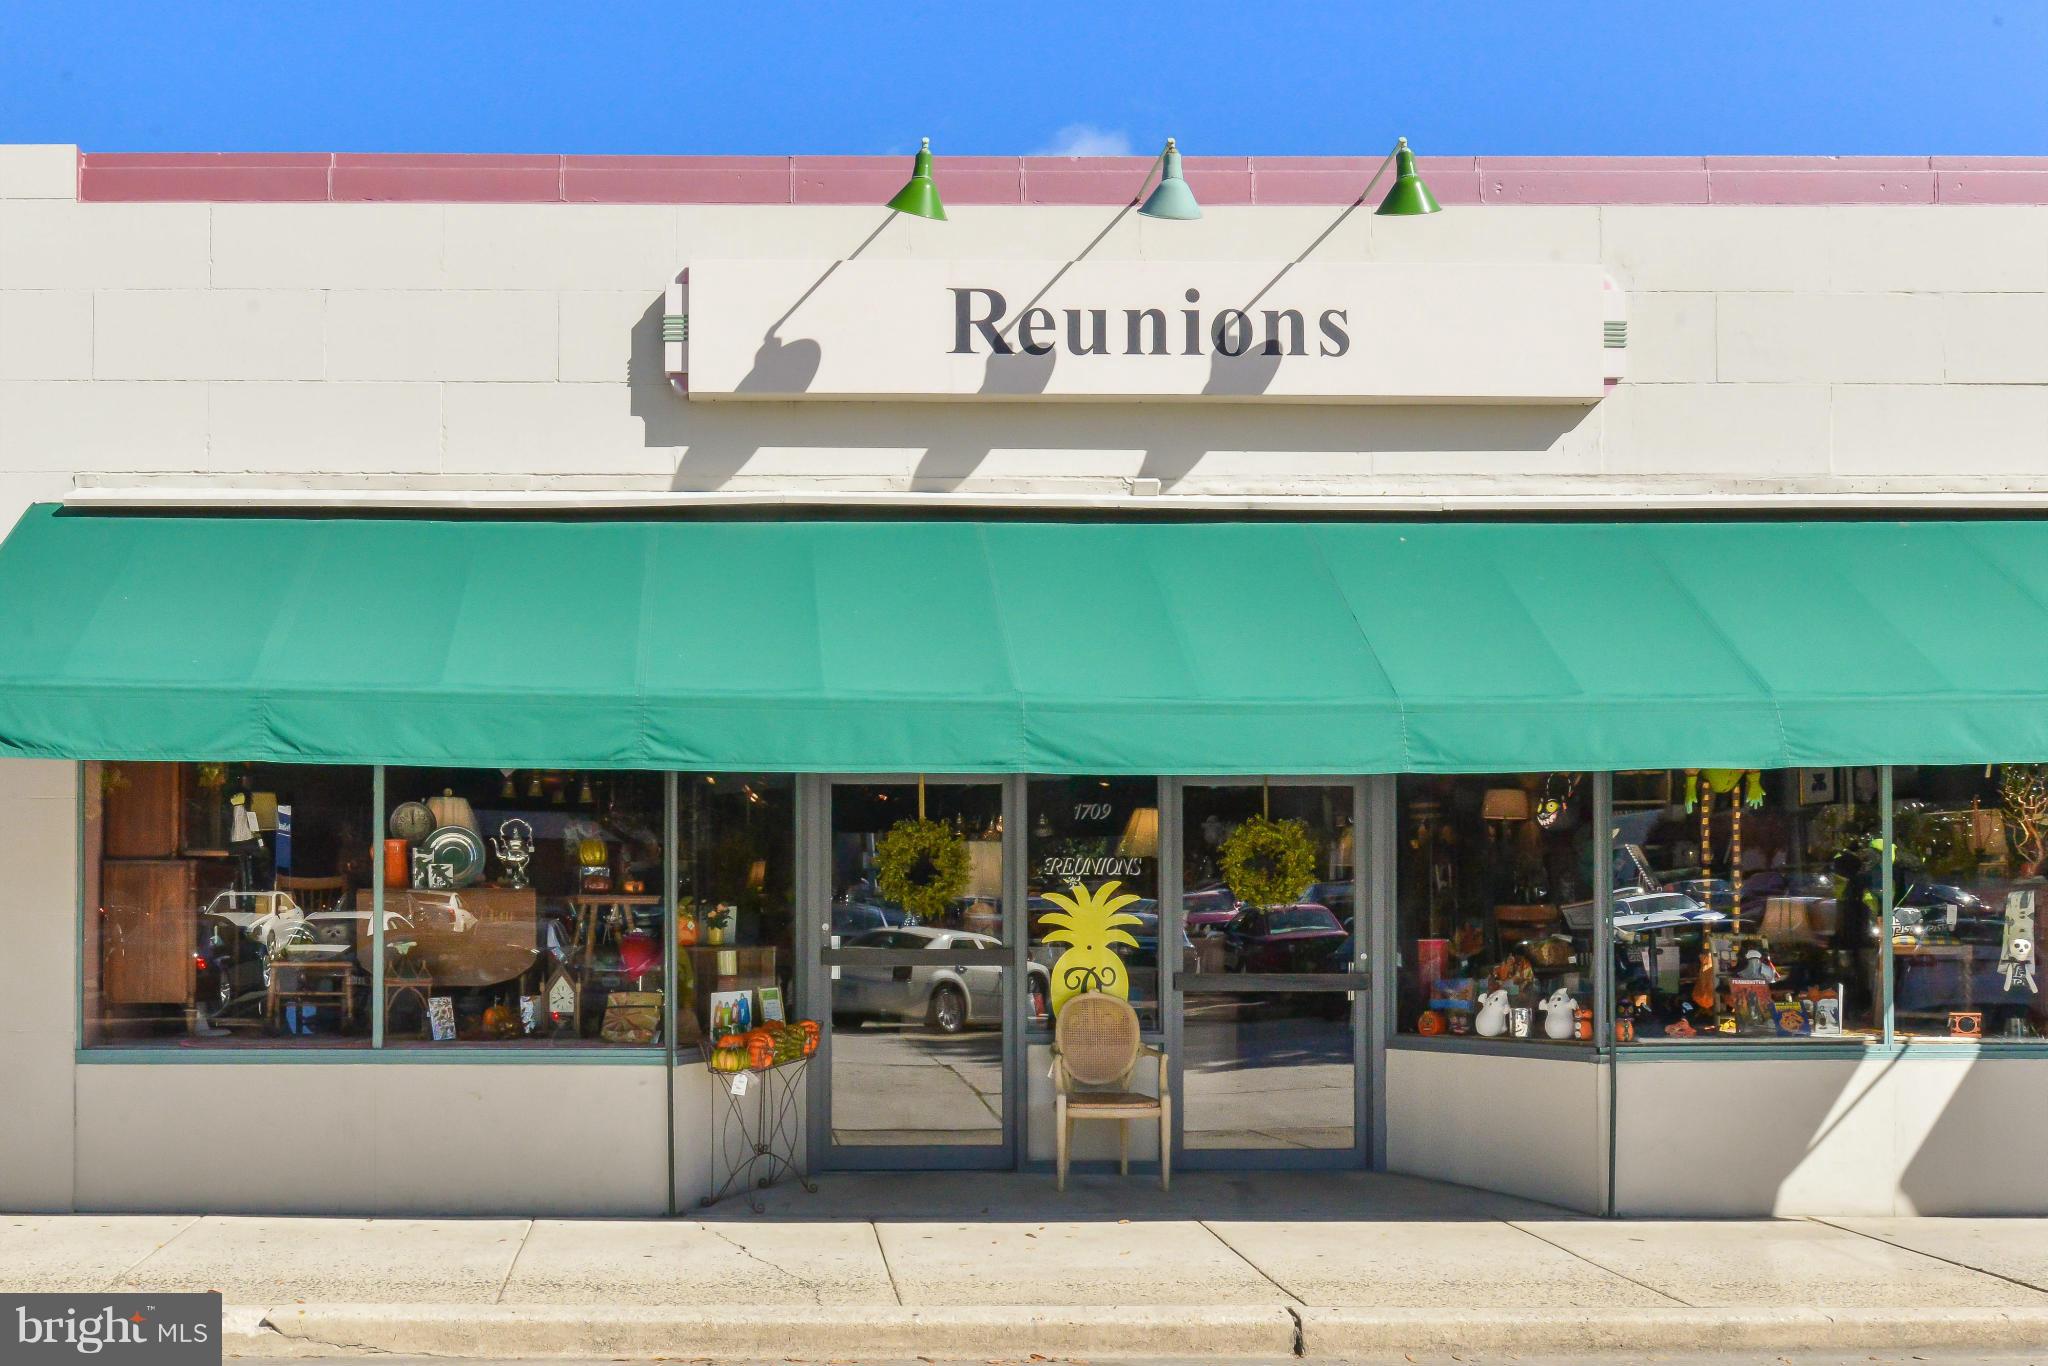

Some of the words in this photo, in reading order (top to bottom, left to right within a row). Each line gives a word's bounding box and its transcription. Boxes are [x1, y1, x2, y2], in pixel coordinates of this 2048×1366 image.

[946, 287, 1351, 358] Reunions
[1074, 803, 1112, 821] 1709
[1045, 856, 1142, 876] REUNIONS
